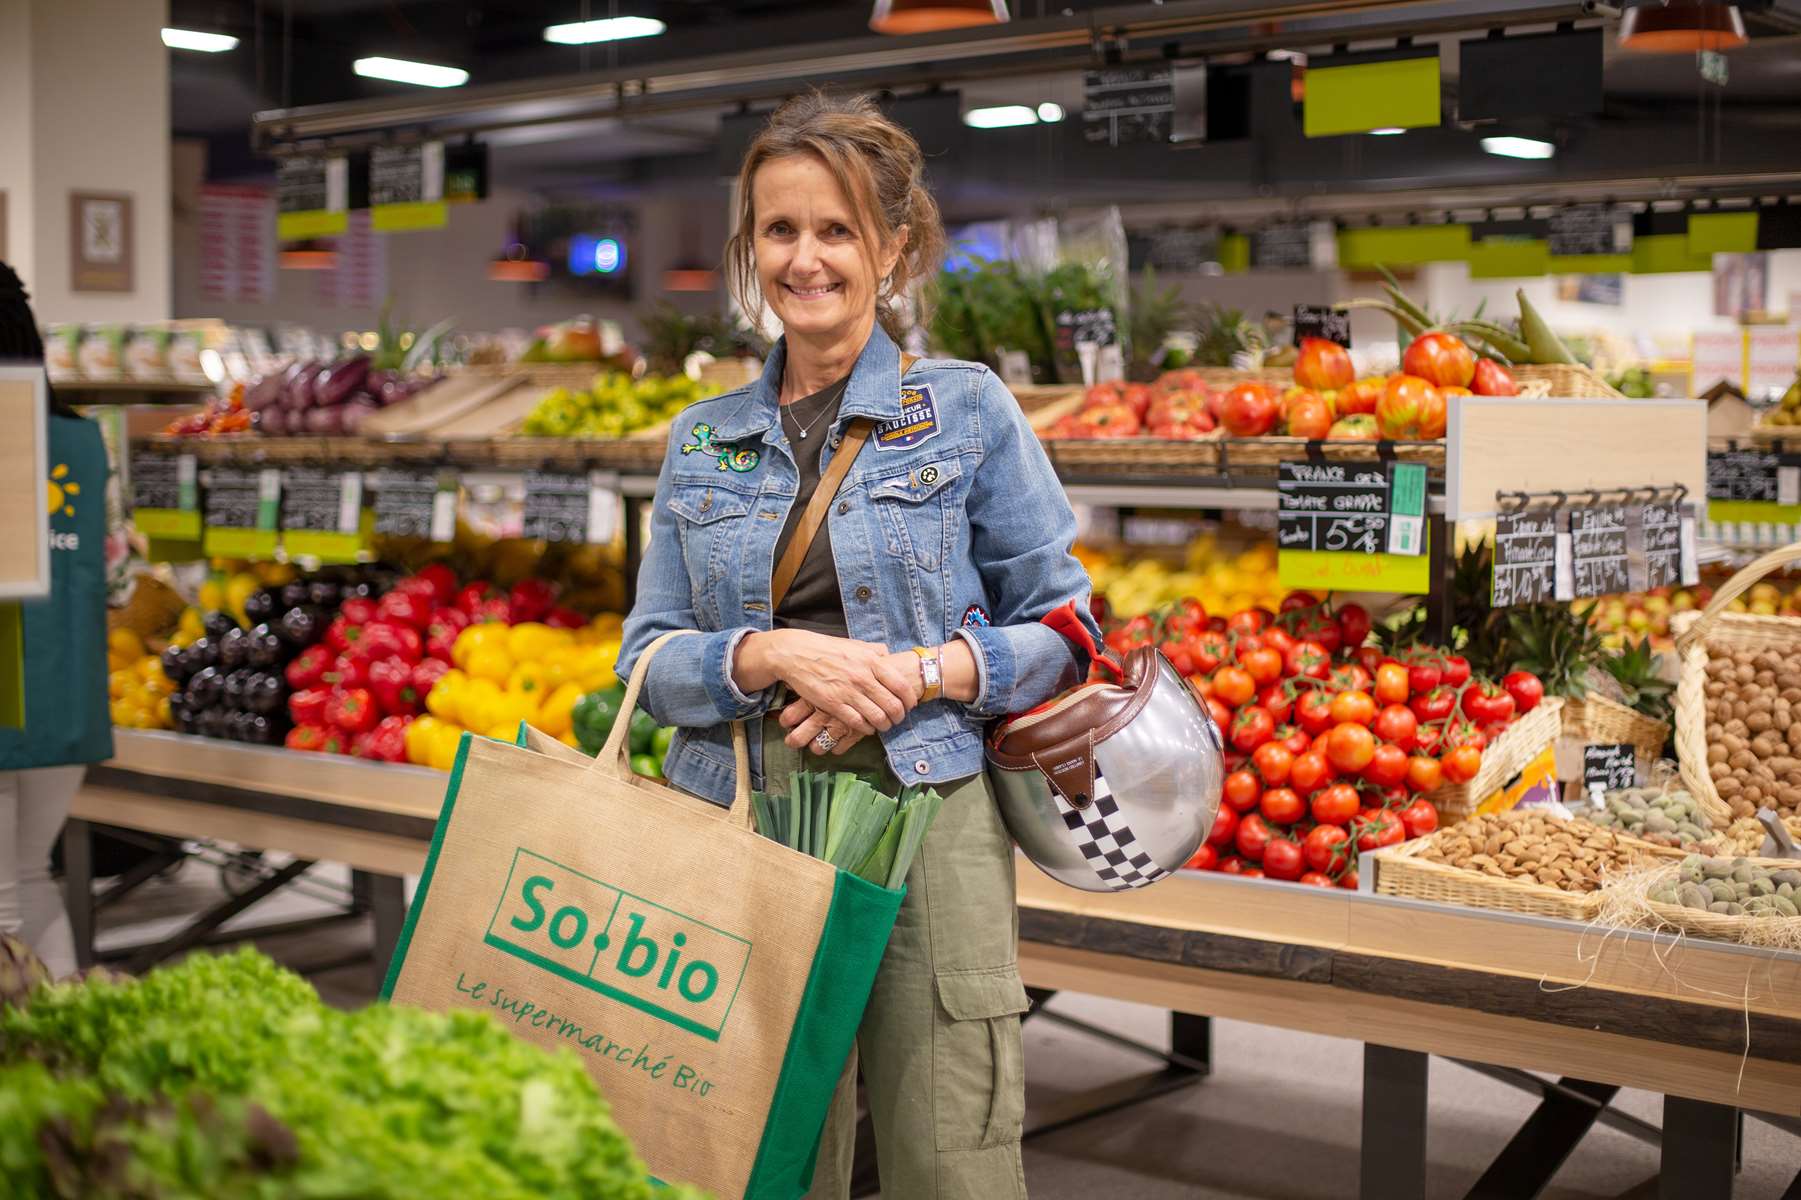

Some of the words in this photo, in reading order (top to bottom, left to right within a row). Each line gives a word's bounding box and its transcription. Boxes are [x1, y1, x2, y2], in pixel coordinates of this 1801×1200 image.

[877, 408, 933, 434] SAUCISSE
[48, 528, 80, 551] ice
[455, 972, 487, 1000] Le
[489, 986, 675, 1080] supermarché
[672, 1064, 716, 1098] Bio
